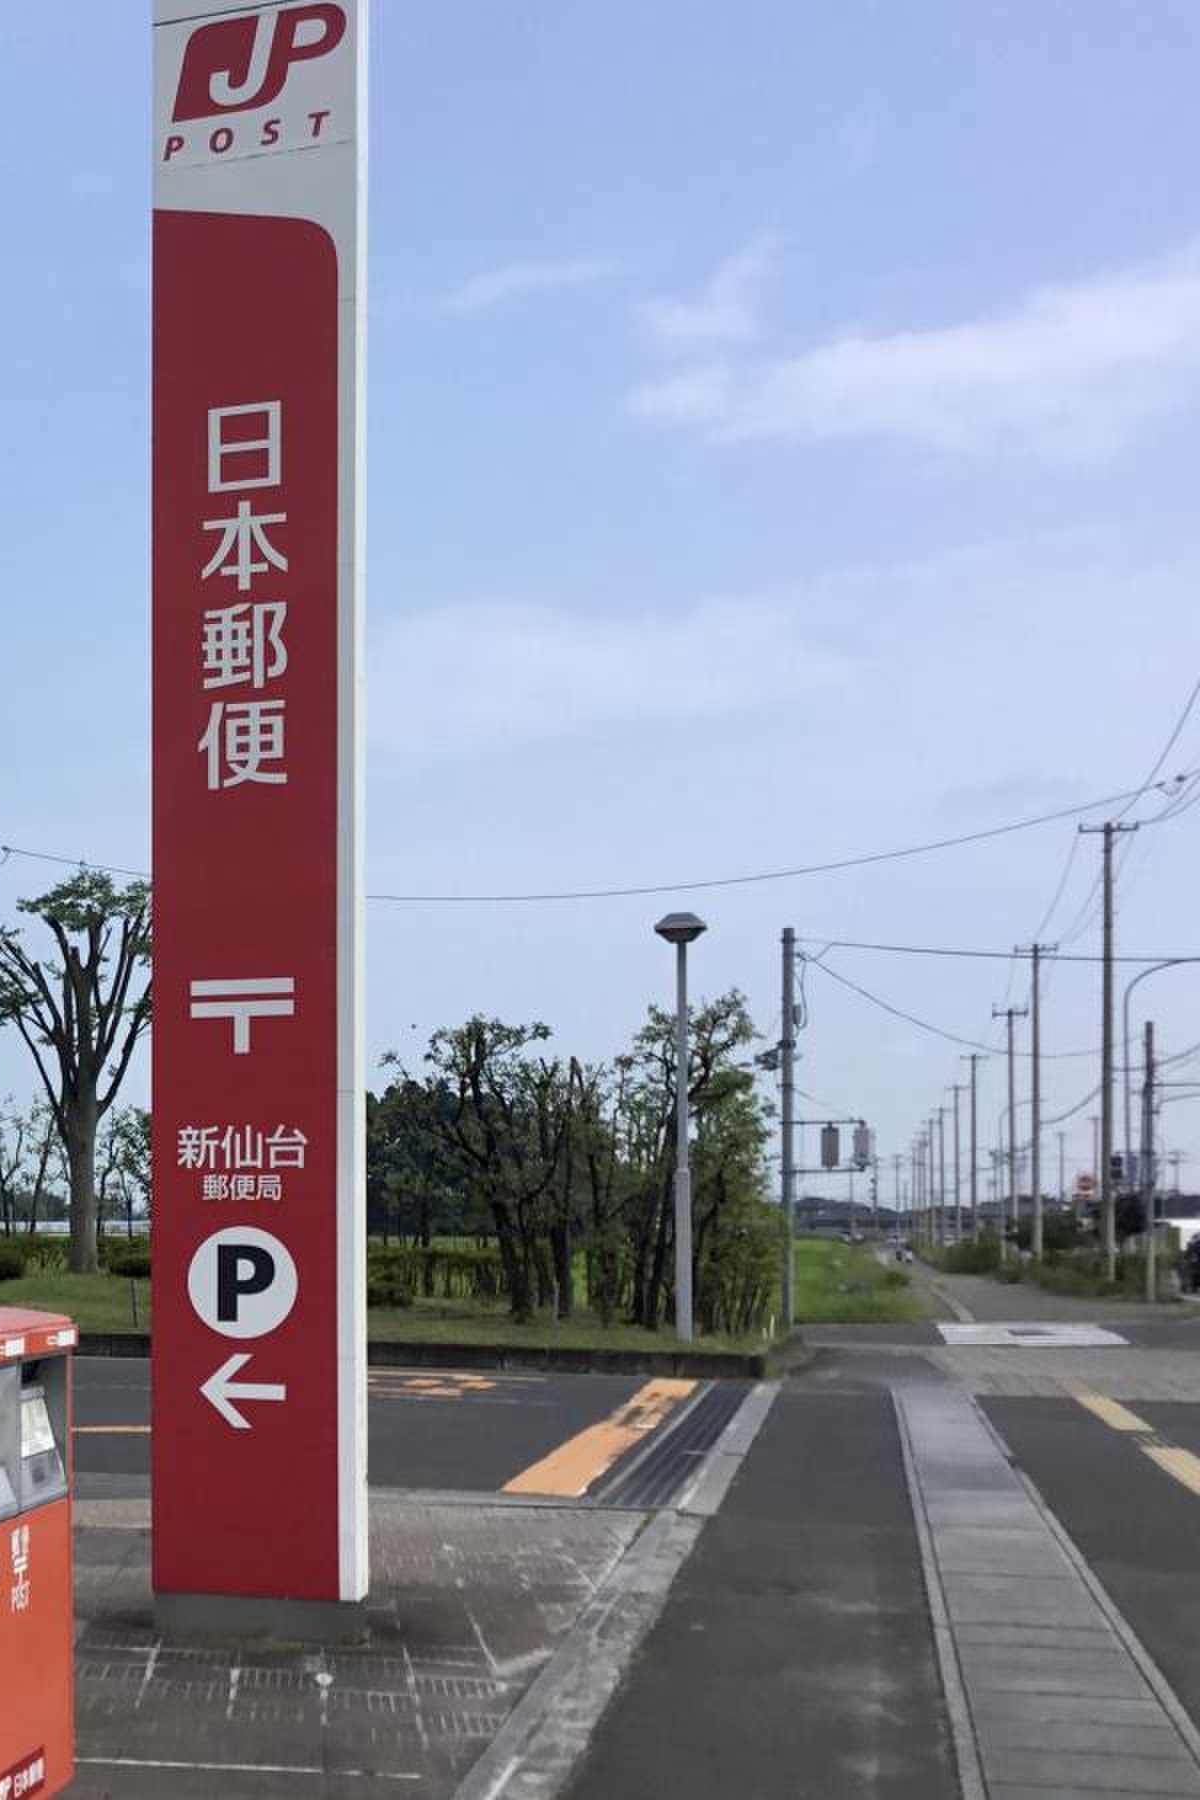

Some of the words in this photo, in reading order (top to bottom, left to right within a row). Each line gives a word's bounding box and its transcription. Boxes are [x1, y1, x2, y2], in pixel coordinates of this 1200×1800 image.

[172, 3, 347, 123] JP
[162, 110, 330, 161] POST
[198, 400, 289, 790] 日本郵便
[176, 1124, 308, 1169] 新仙台
[202, 1174, 283, 1201] 郵便局
[217, 1243, 276, 1323] P
